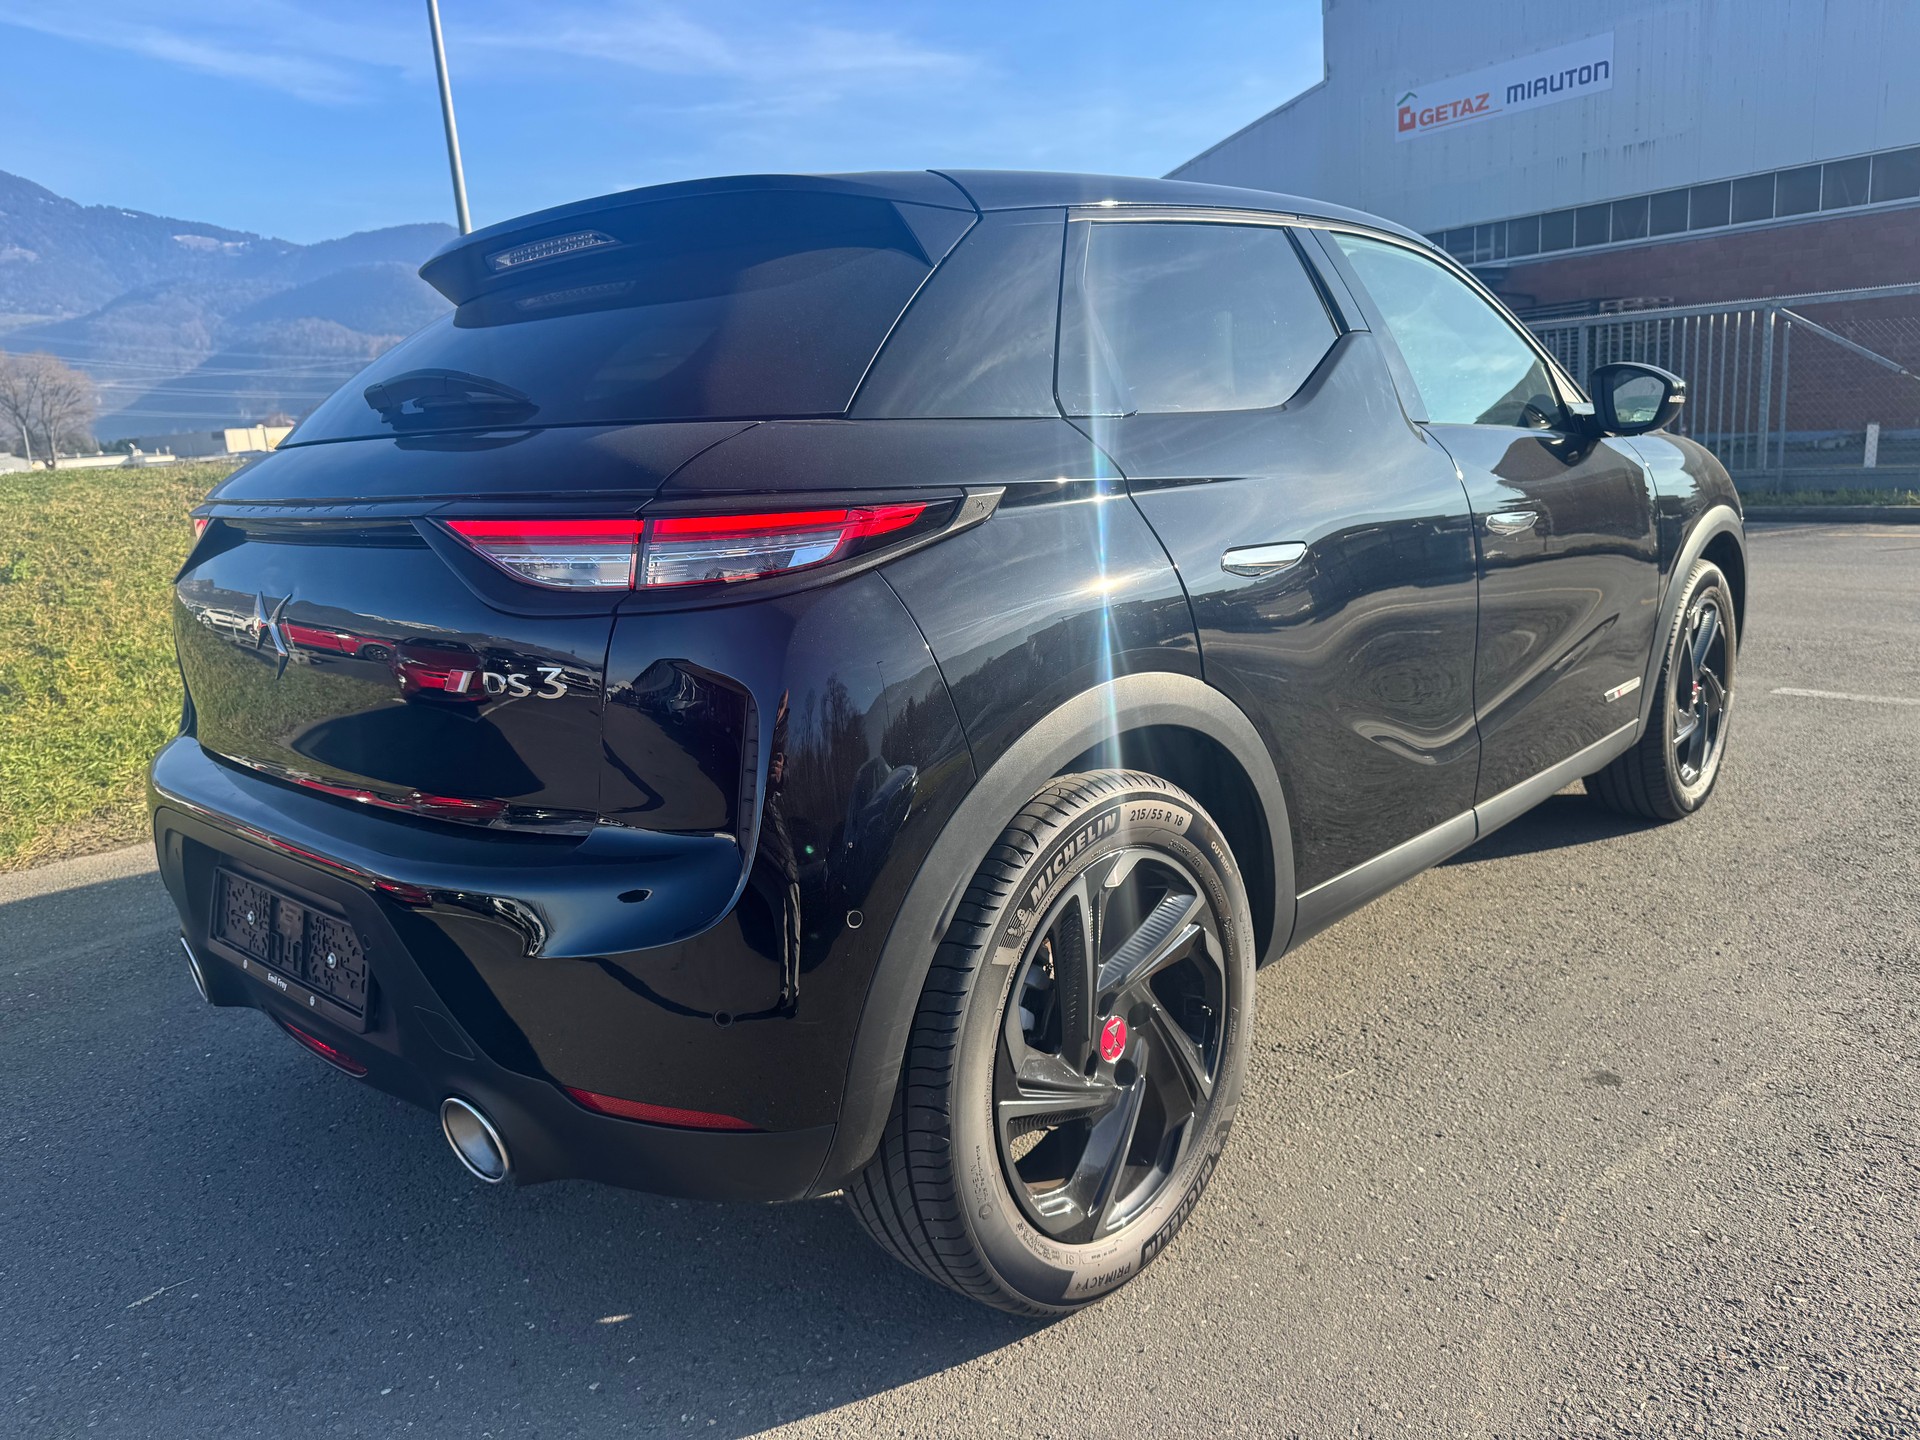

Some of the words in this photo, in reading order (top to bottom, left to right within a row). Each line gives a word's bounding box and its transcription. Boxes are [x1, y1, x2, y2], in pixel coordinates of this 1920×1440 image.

[1418, 92, 1490, 127] GETAZ
[1505, 60, 1610, 105] MIAUTON
[483, 671, 532, 698] DS
[536, 666, 568, 700] 3
[1130, 808, 1164, 822] 215/55
[1164, 811, 1172, 822] R
[1174, 814, 1184, 826] 18
[1030, 811, 1118, 907] MICHELIN
[1211, 840, 1233, 876] OUTSIDE
[1081, 1261, 1131, 1290] PRIMACY
